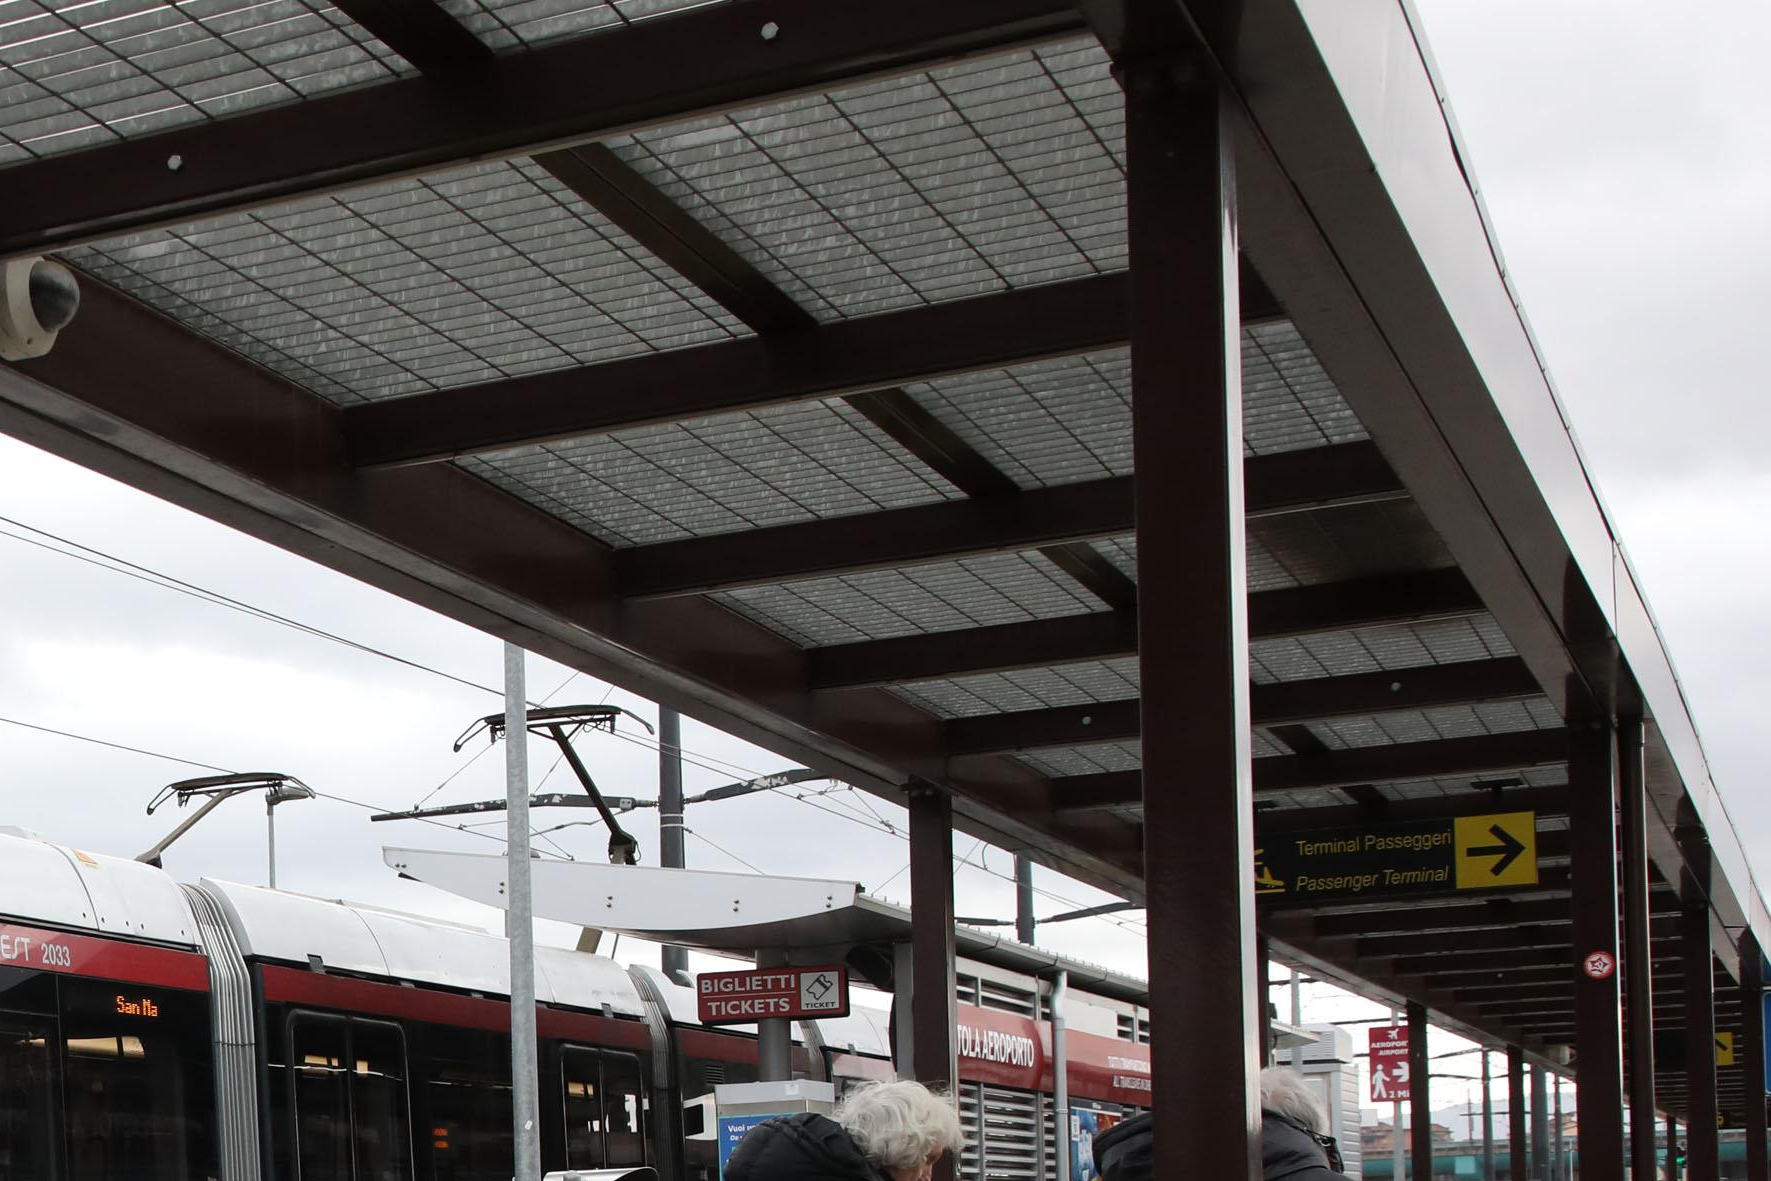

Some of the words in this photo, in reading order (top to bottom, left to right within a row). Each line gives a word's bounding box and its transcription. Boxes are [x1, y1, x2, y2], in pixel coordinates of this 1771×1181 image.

[1295, 836, 1360, 856] Terminal
[1364, 829, 1452, 851] Passeggeri
[1296, 873, 1379, 892] Passenger
[1383, 866, 1450, 885] Terminal
[40, 943, 71, 967] 2033
[701, 974, 795, 994] BIGLIETTI
[116, 995, 140, 1015] San
[707, 998, 790, 1016] TICKETS
[805, 1001, 836, 1009] TICKET
[982, 1029, 1035, 1068] AEROPORTO
[1371, 1040, 1409, 1049] AEROPOR
